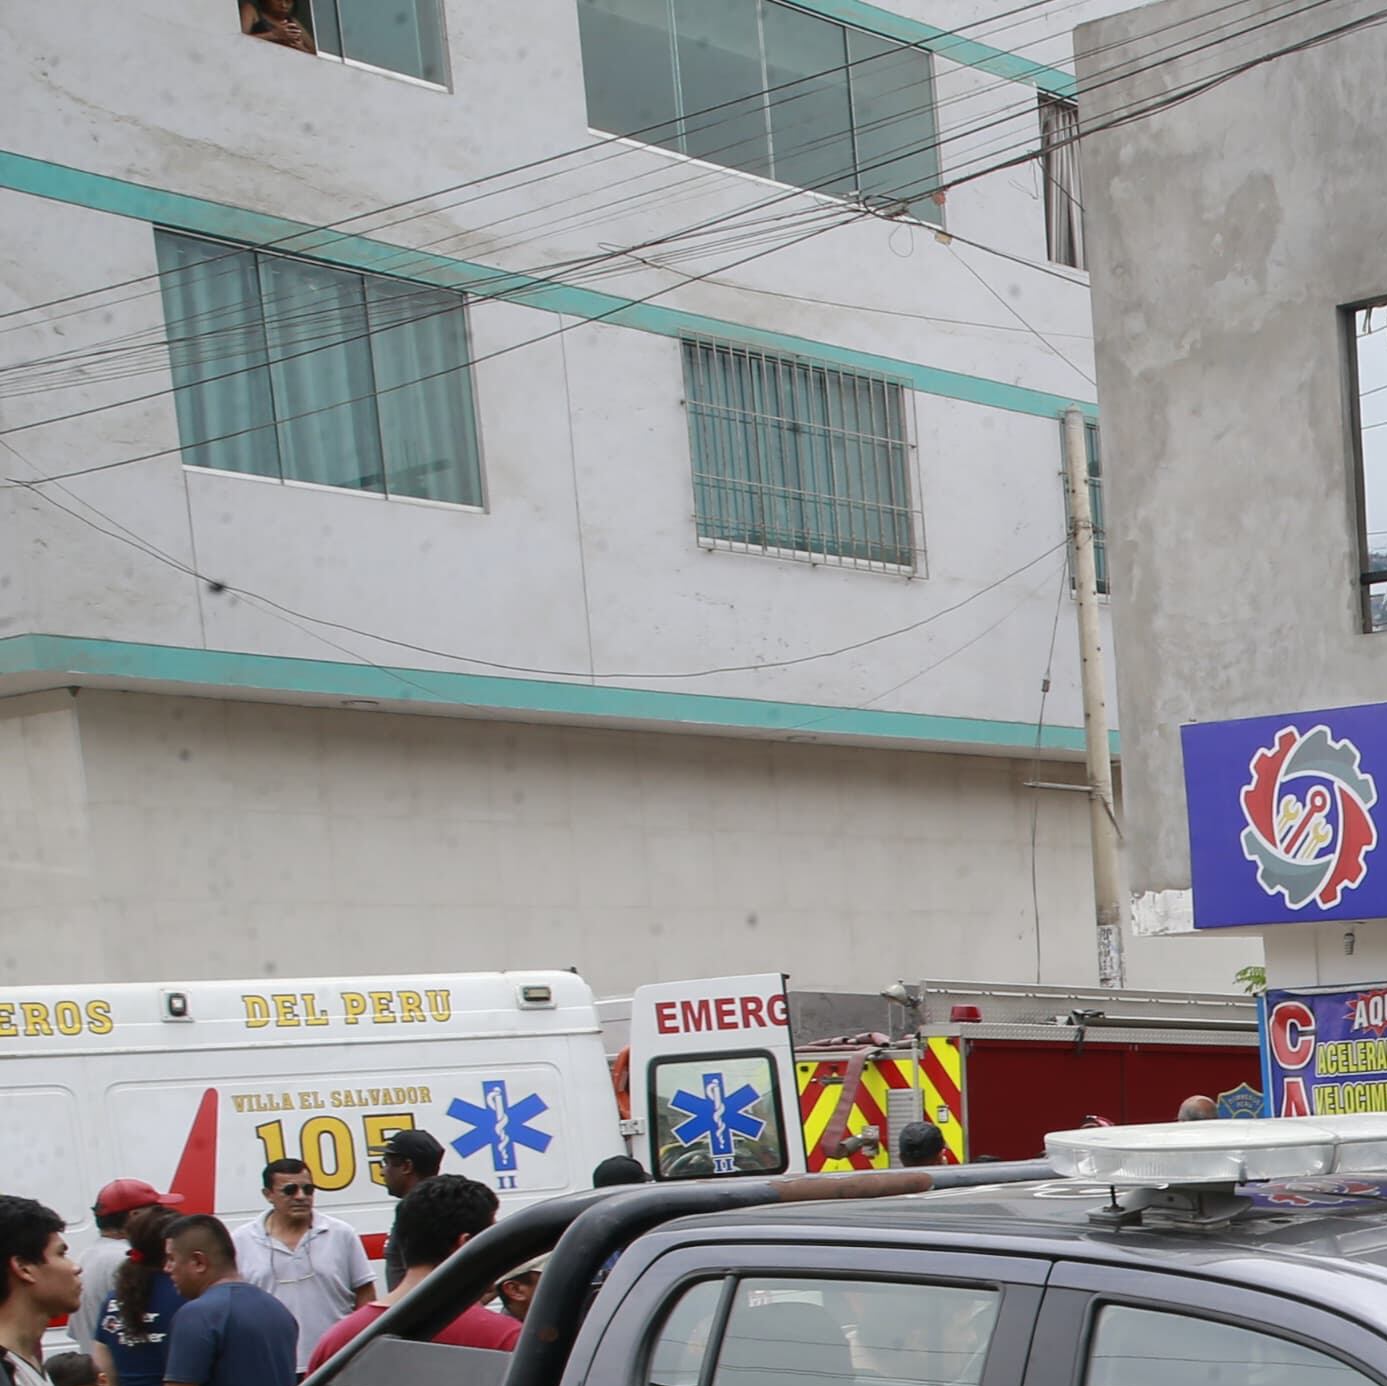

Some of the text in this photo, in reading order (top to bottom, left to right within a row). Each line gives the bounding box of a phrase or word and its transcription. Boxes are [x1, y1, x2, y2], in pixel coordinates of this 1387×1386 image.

[242, 990, 451, 1028] DEL PERU
[655, 994, 790, 1034] EMERG
[231, 1086, 432, 1112] VILLA EL SALVADOR
